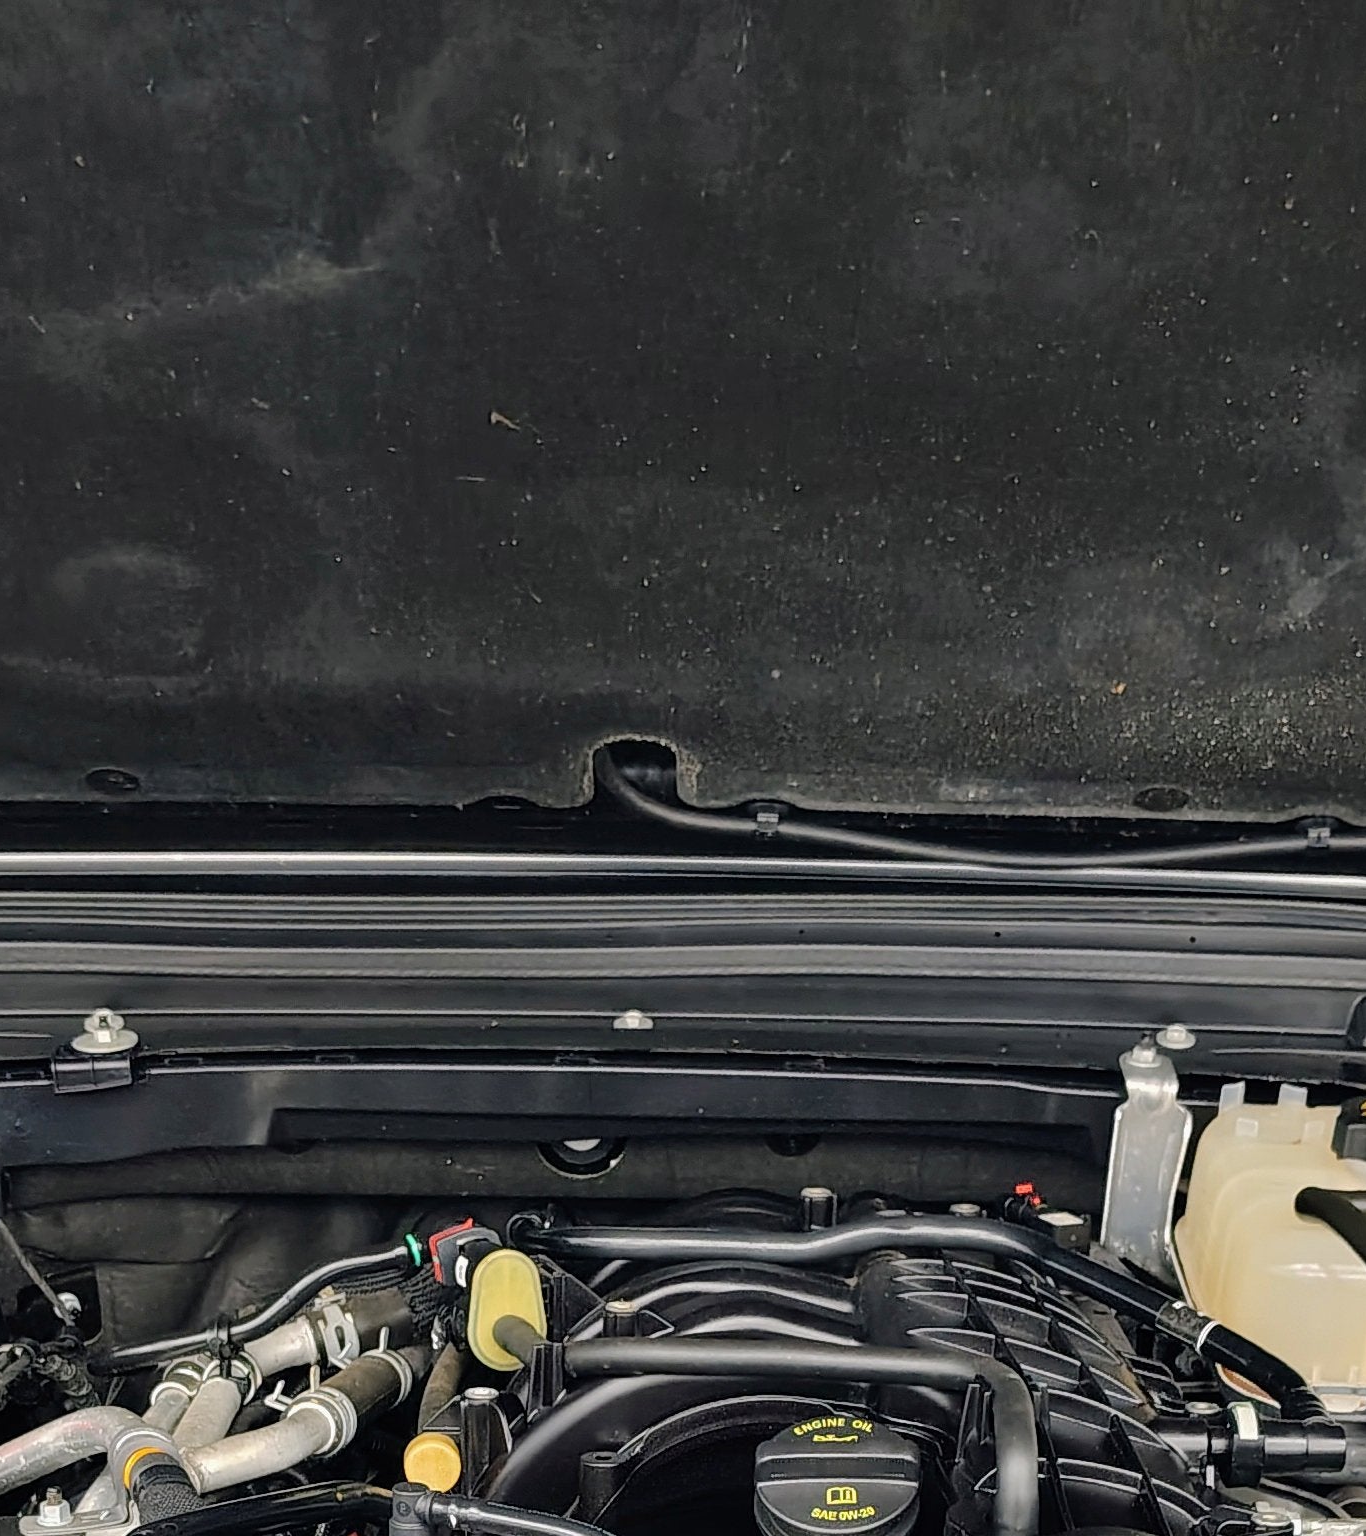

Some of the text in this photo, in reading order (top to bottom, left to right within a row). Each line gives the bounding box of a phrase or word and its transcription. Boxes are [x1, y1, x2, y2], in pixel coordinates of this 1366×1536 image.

[793, 1417, 874, 1436] ENGINE OIL
[810, 1505, 876, 1522] SAE 0W-20
